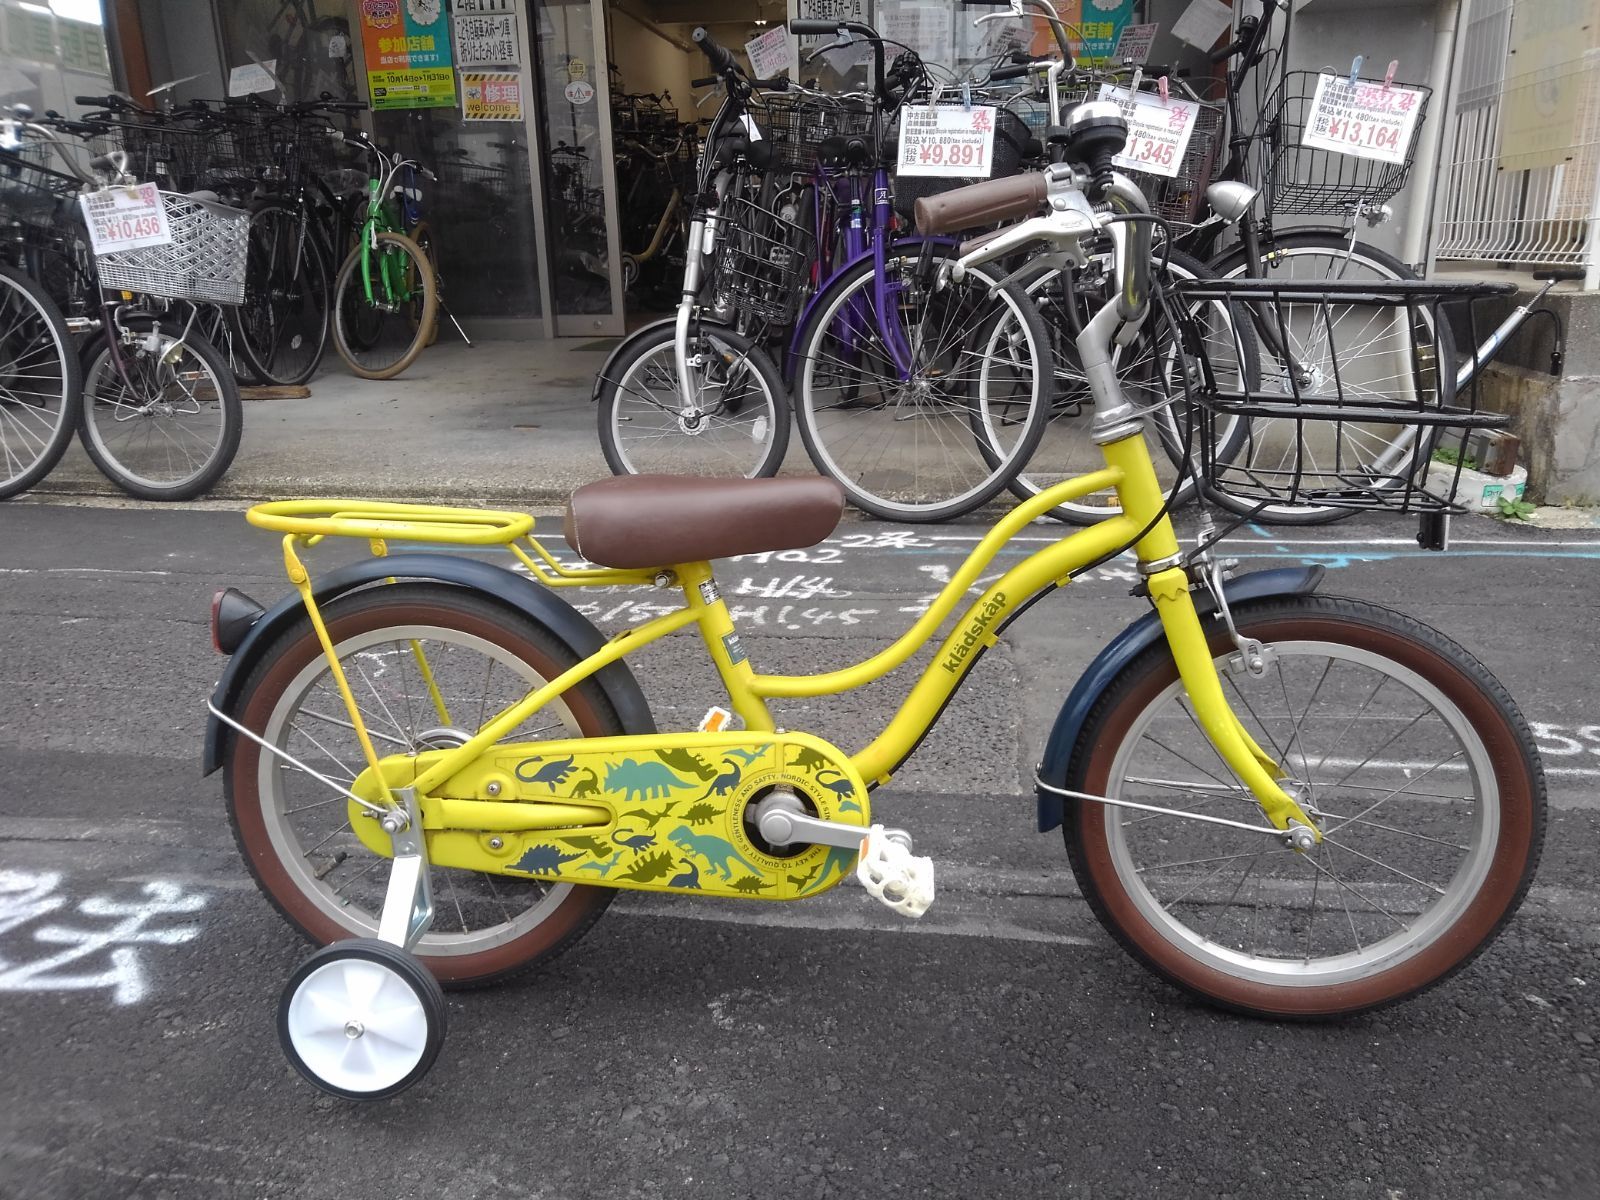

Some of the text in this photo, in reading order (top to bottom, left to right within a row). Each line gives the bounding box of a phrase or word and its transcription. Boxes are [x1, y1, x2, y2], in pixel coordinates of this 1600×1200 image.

[378, 34, 435, 53] 参加店舗
[460, 40, 513, 62] 折りたたみ小径車
[485, 84, 518, 102] 修理
[1325, 82, 1358, 95] 中古自転車
[468, 103, 511, 112] welcome
[907, 111, 938, 119] 中古自転車
[1328, 117, 1399, 149] ¥13,164
[919, 144, 984, 165] ¥9,891
[105, 216, 161, 240] ¥10,436
[942, 591, 1006, 674] klädskåp
[740, 784, 754, 798] AND
[781, 773, 832, 821] NORDIC STYLE SIN
[733, 799, 744, 843] GENTLENESS
[742, 843, 749, 852] IS
[810, 846, 822, 857] THE
[750, 851, 780, 868] QUALITY
[795, 856, 810, 868] KEY
